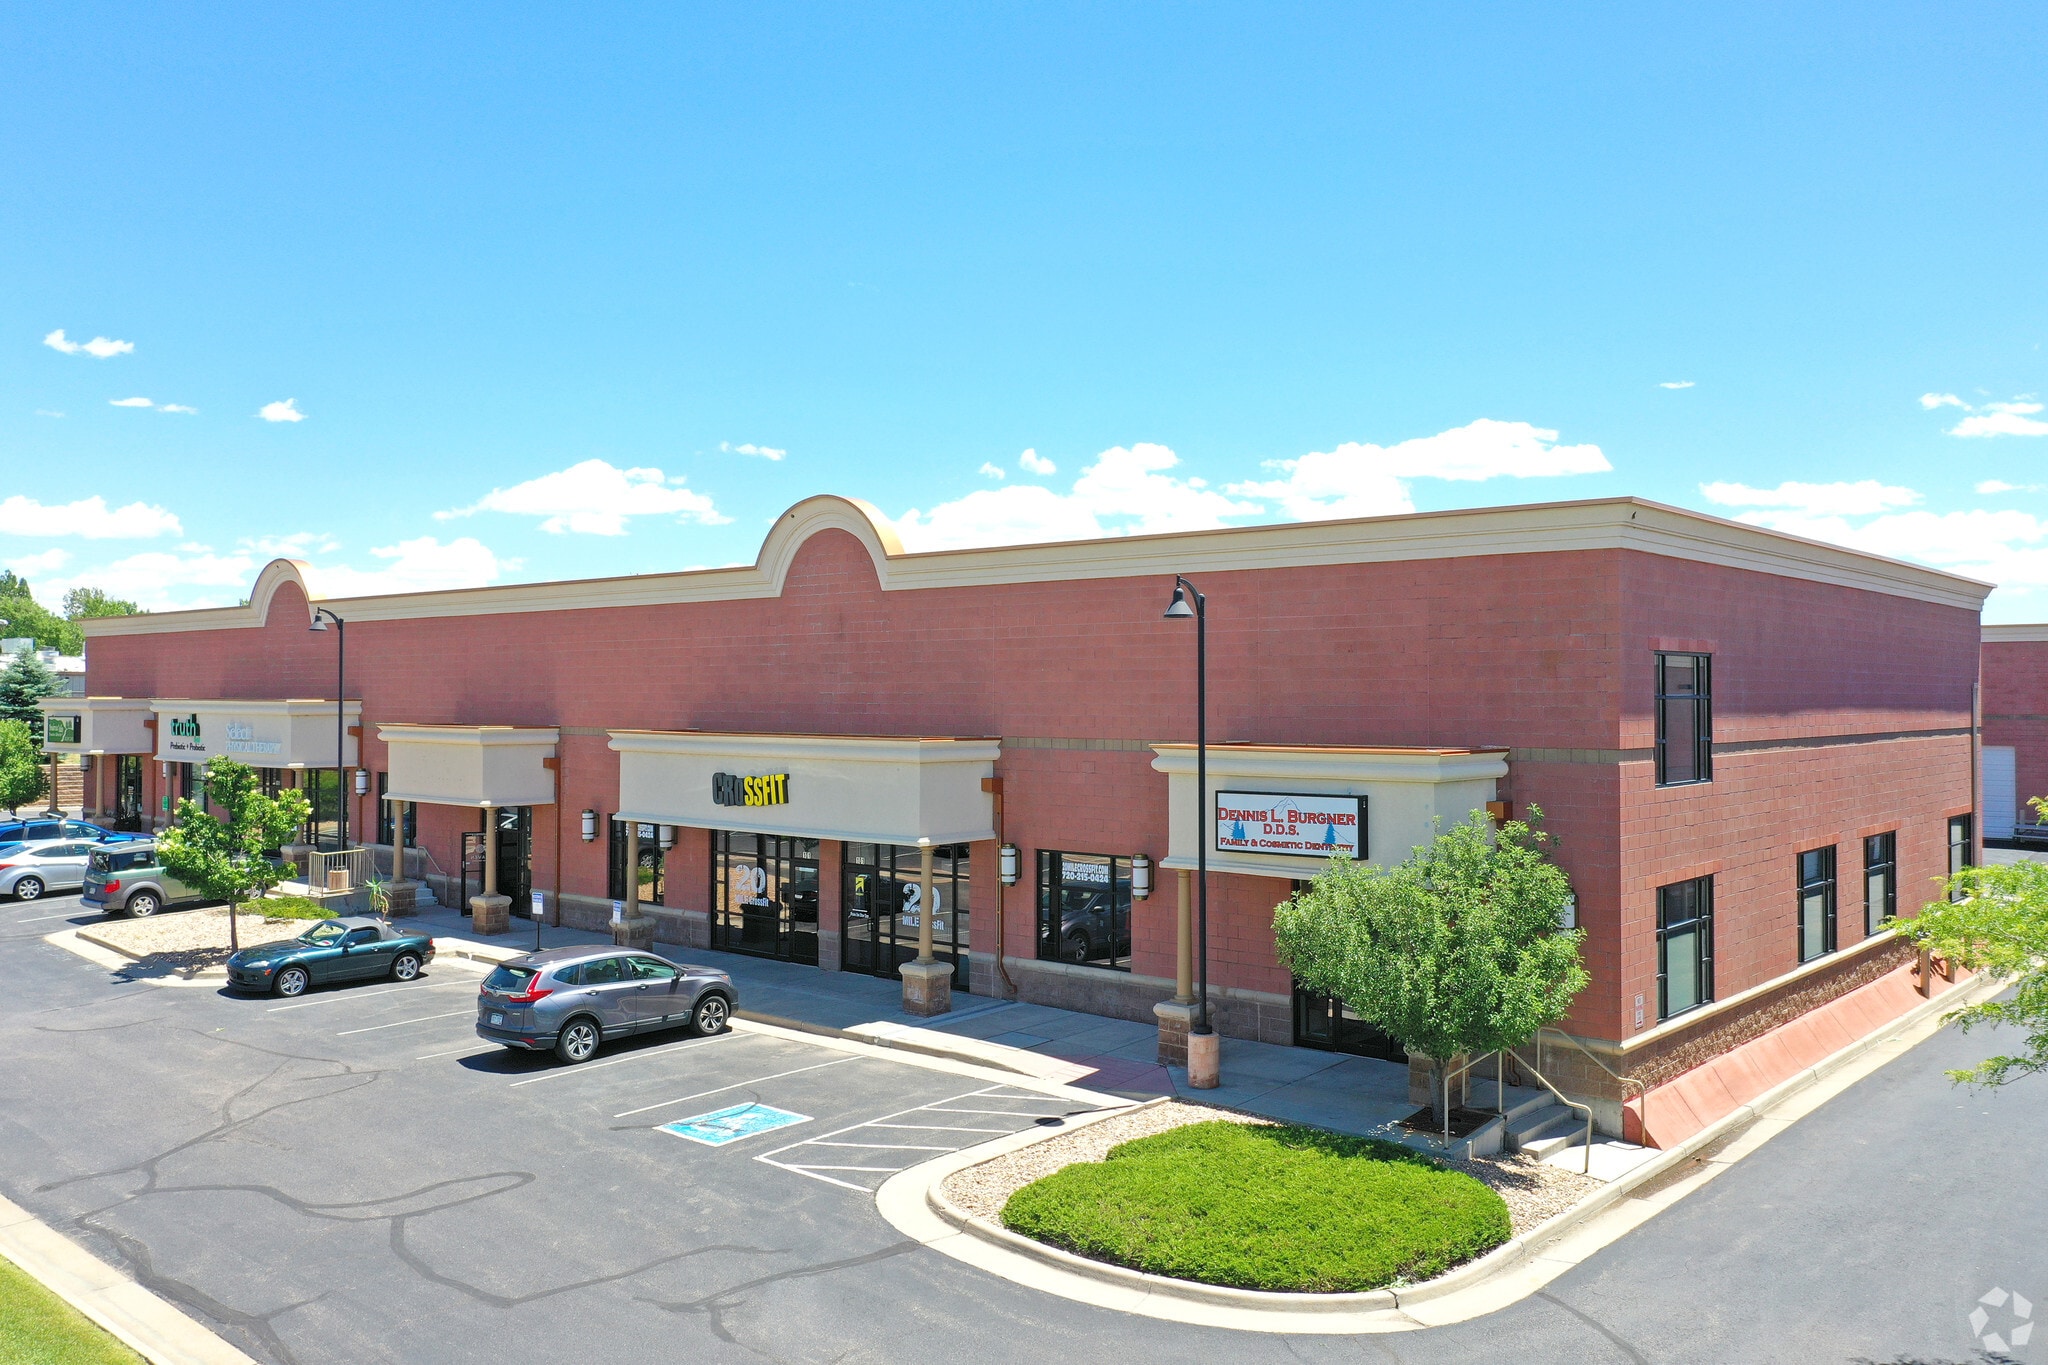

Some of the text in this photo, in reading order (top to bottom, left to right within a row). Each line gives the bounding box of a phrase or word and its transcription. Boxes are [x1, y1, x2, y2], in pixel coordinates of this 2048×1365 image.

[170, 713, 200, 736] truth
[226, 723, 252, 740] Select
[1218, 807, 1356, 826] DENNIS L. BURGNER
[1263, 824, 1300, 836] D.D.S.
[1220, 837, 1249, 847] FAMILY
[1251, 839, 1258, 847] &
[1259, 839, 1303, 849] COSMETIC
[735, 864, 766, 894] 20
[1062, 871, 1109, 883] 720-215-0424
[902, 915, 919, 927] MILE
